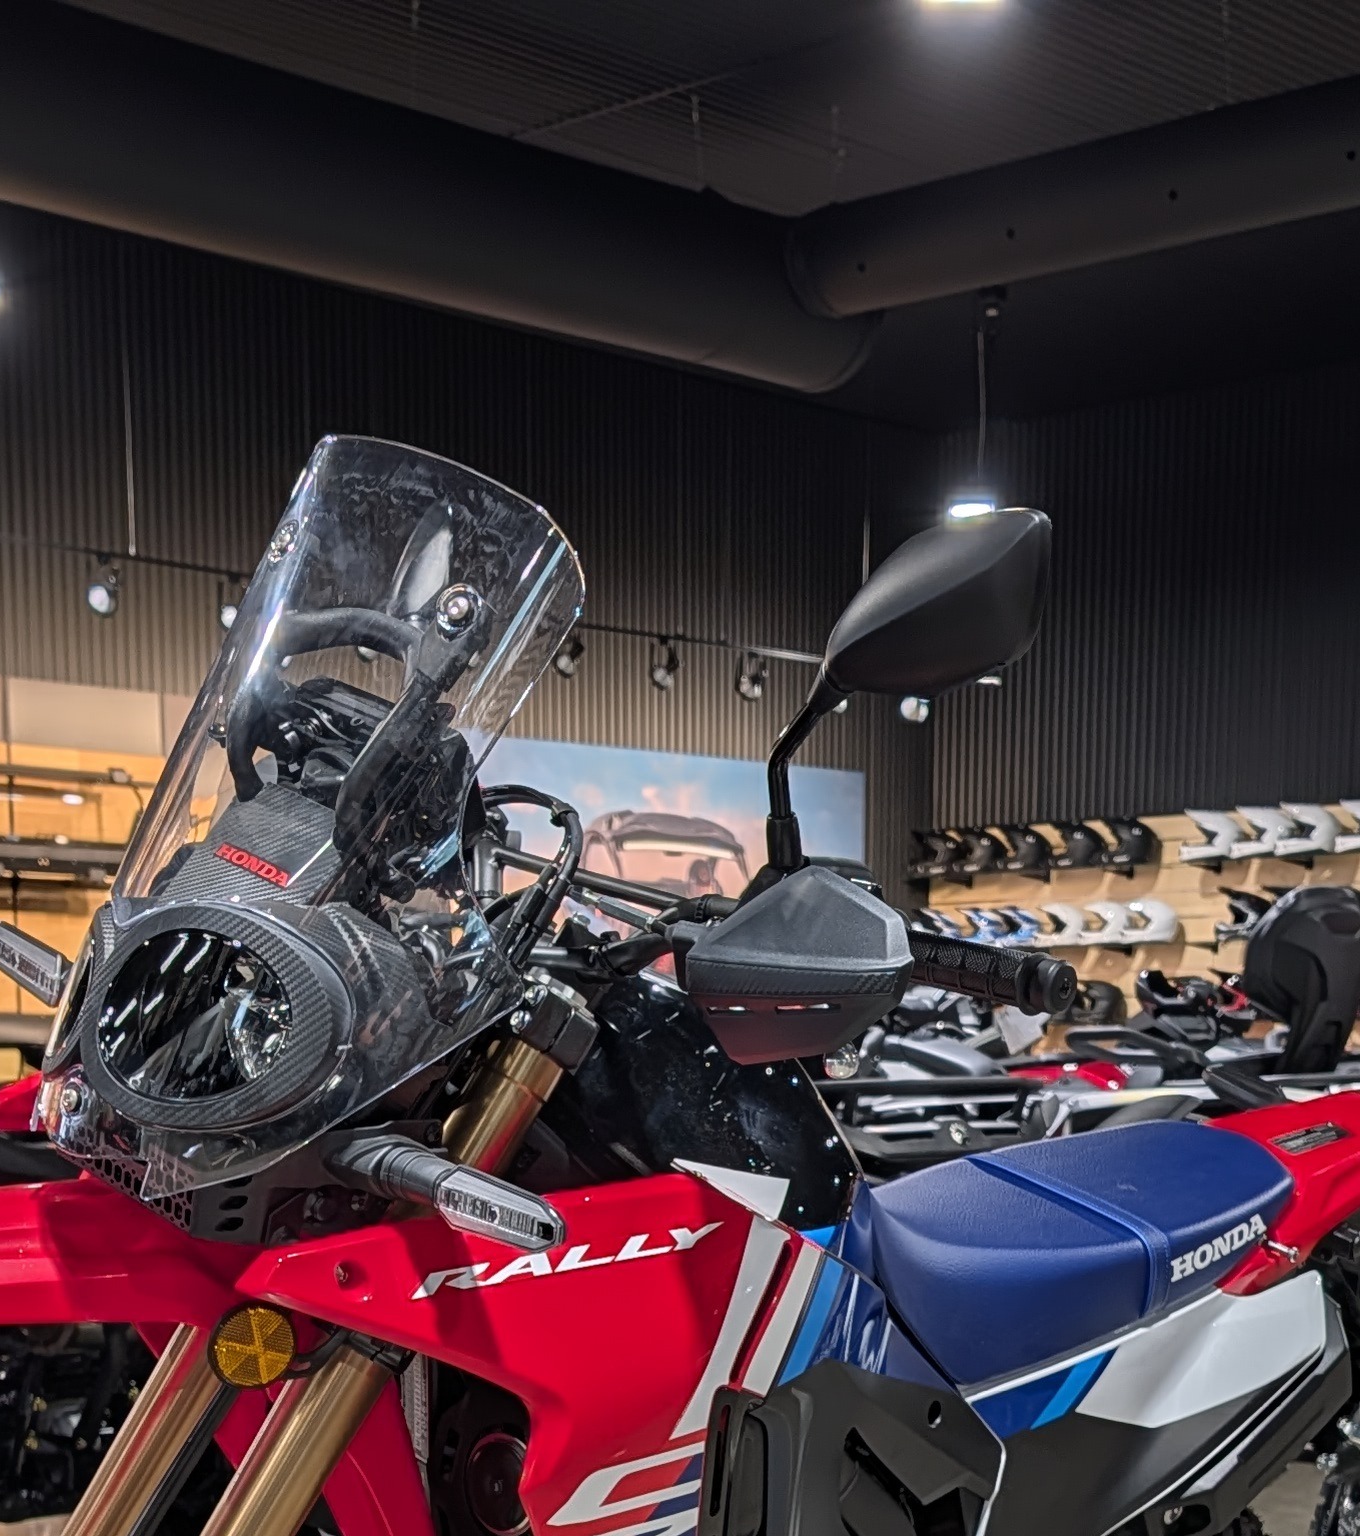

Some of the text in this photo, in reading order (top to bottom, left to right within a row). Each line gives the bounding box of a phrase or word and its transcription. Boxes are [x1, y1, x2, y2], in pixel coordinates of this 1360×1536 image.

[215, 843, 289, 888] HONDA
[411, 1221, 725, 1300] RALLY
[1170, 1213, 1267, 1283] HONDA
